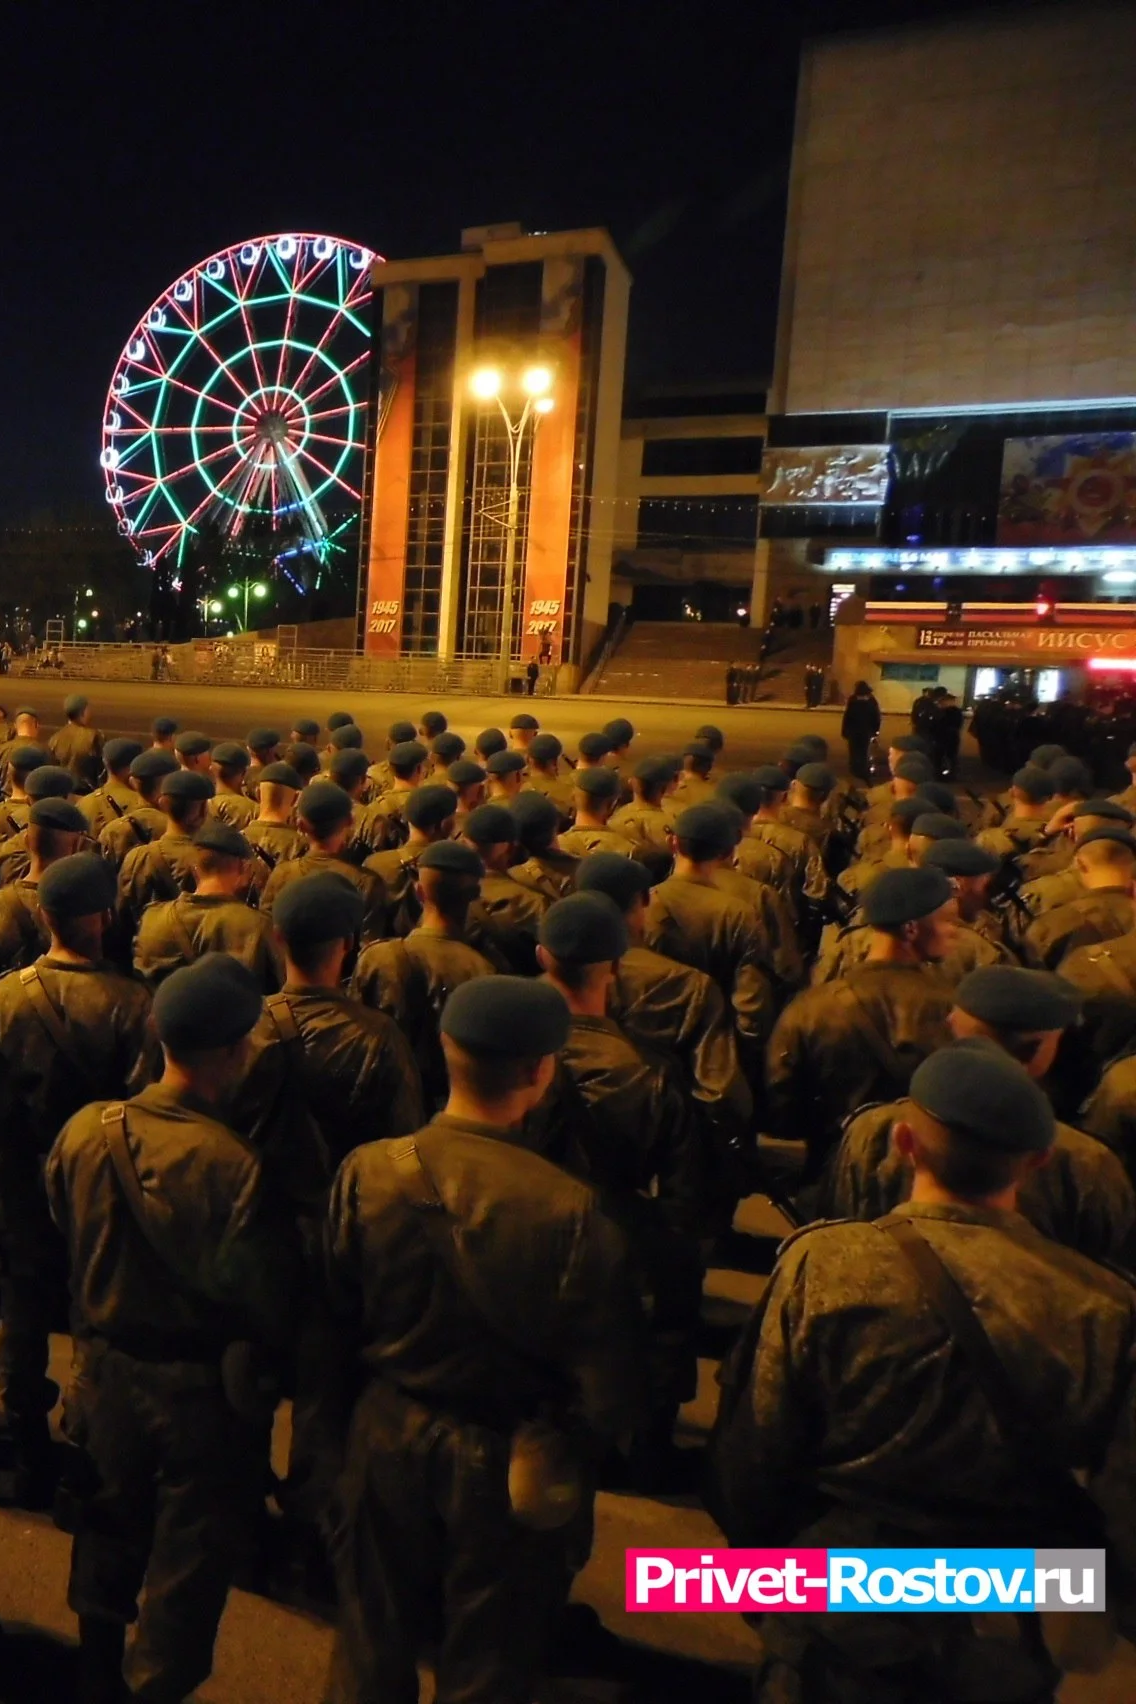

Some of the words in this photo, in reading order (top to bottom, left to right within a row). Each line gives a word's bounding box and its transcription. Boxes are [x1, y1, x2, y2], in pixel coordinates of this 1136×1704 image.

[372, 601, 400, 615] 1945
[530, 600, 561, 616] 1945
[368, 620, 396, 633] 2017
[1038, 632, 1129, 652] ИИСУС
